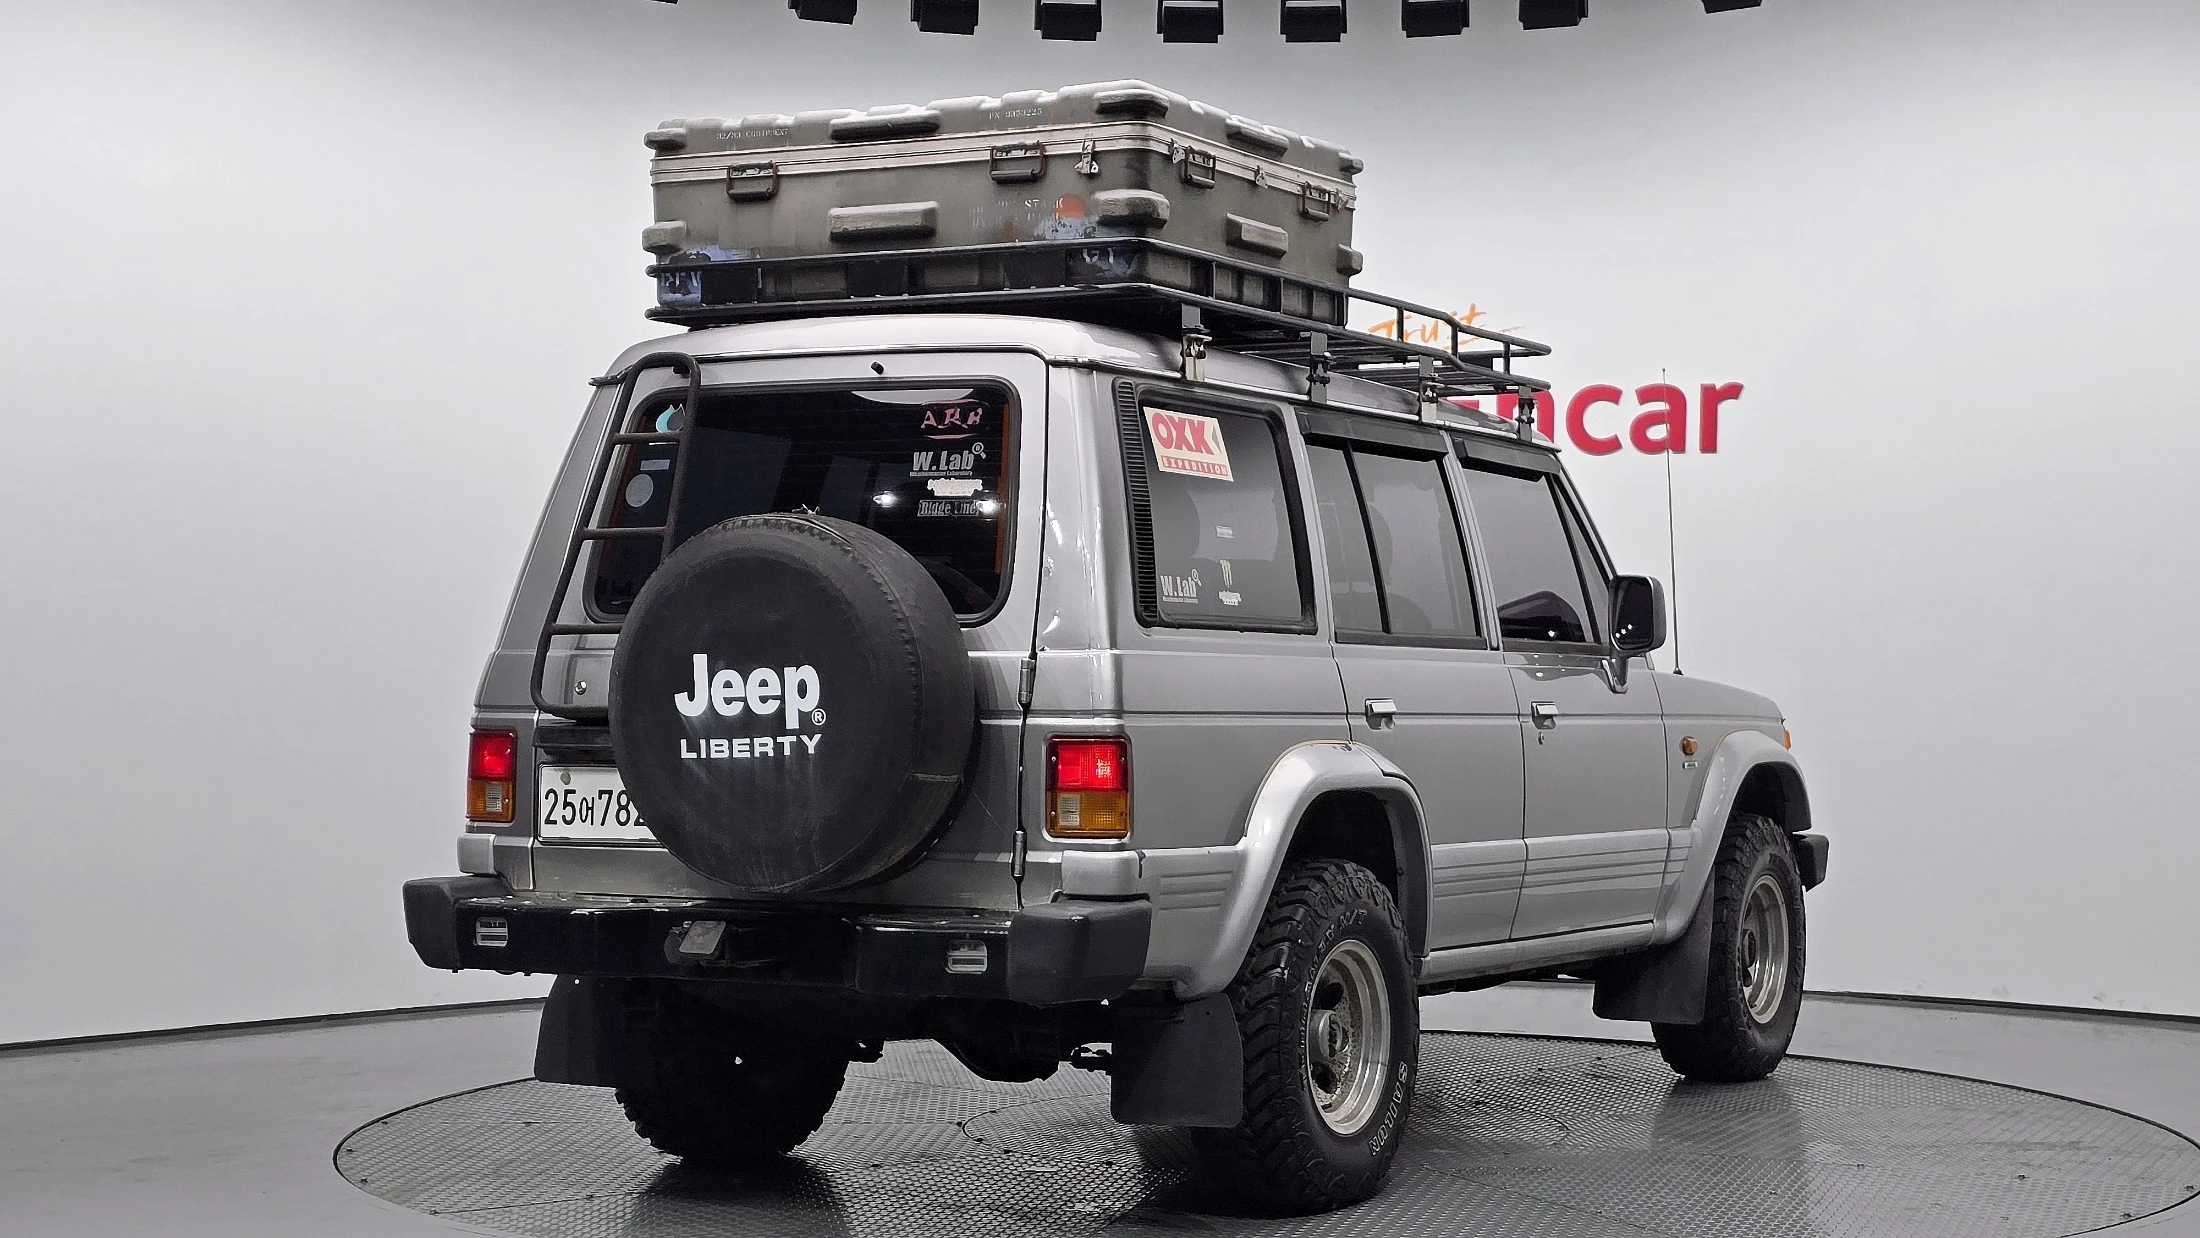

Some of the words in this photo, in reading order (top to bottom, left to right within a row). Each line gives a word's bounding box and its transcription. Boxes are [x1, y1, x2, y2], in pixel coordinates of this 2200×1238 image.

[1368, 303, 1487, 345] Trut
[1151, 412, 1214, 456] OXK
[1441, 380, 1744, 456] ncar
[912, 450, 975, 471] W.Lab
[1162, 456, 1229, 477] EXPEDITION
[1160, 575, 1197, 598] W.Lab
[674, 653, 821, 729] Jeep
[680, 733, 822, 760] LIBERTY
